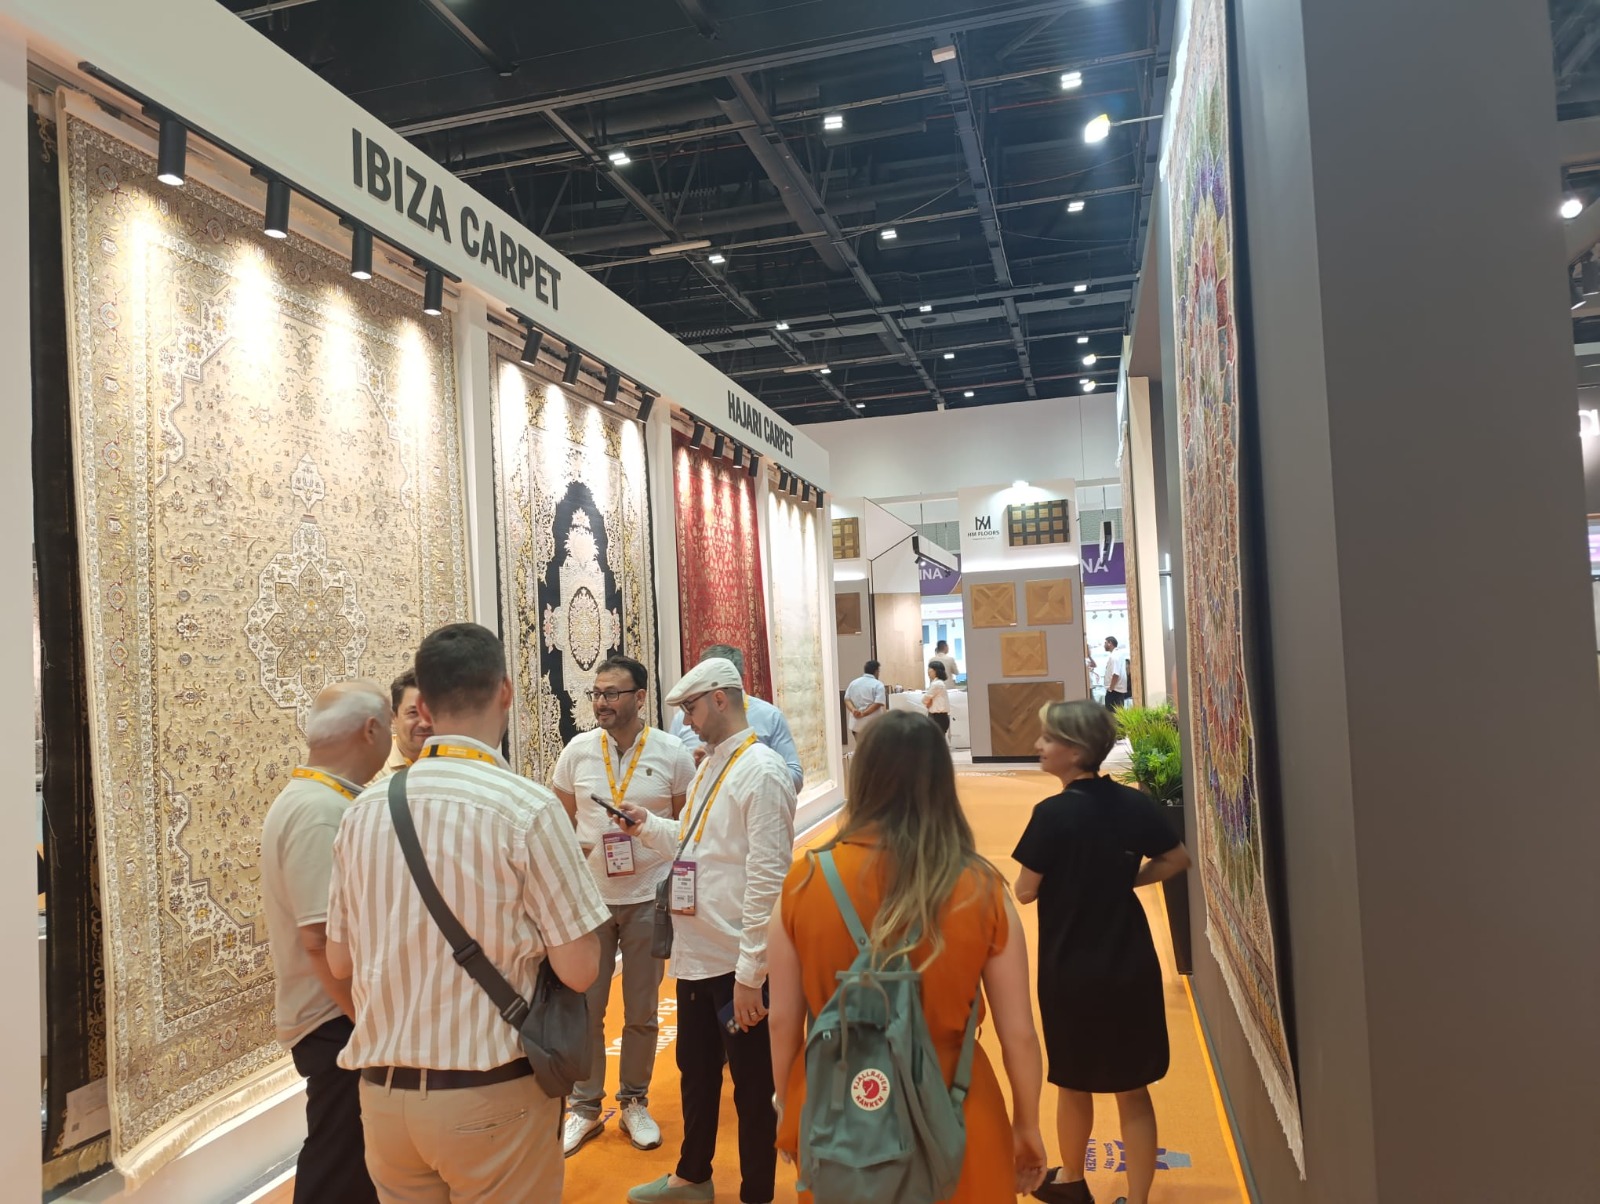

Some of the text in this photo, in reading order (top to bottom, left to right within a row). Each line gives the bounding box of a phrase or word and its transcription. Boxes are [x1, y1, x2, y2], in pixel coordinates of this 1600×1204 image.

[352, 127, 561, 311] IBIZA CARPET
[728, 390, 794, 459] HAJARI CARPET
[1086, 1148, 1096, 1172] MAZEN
